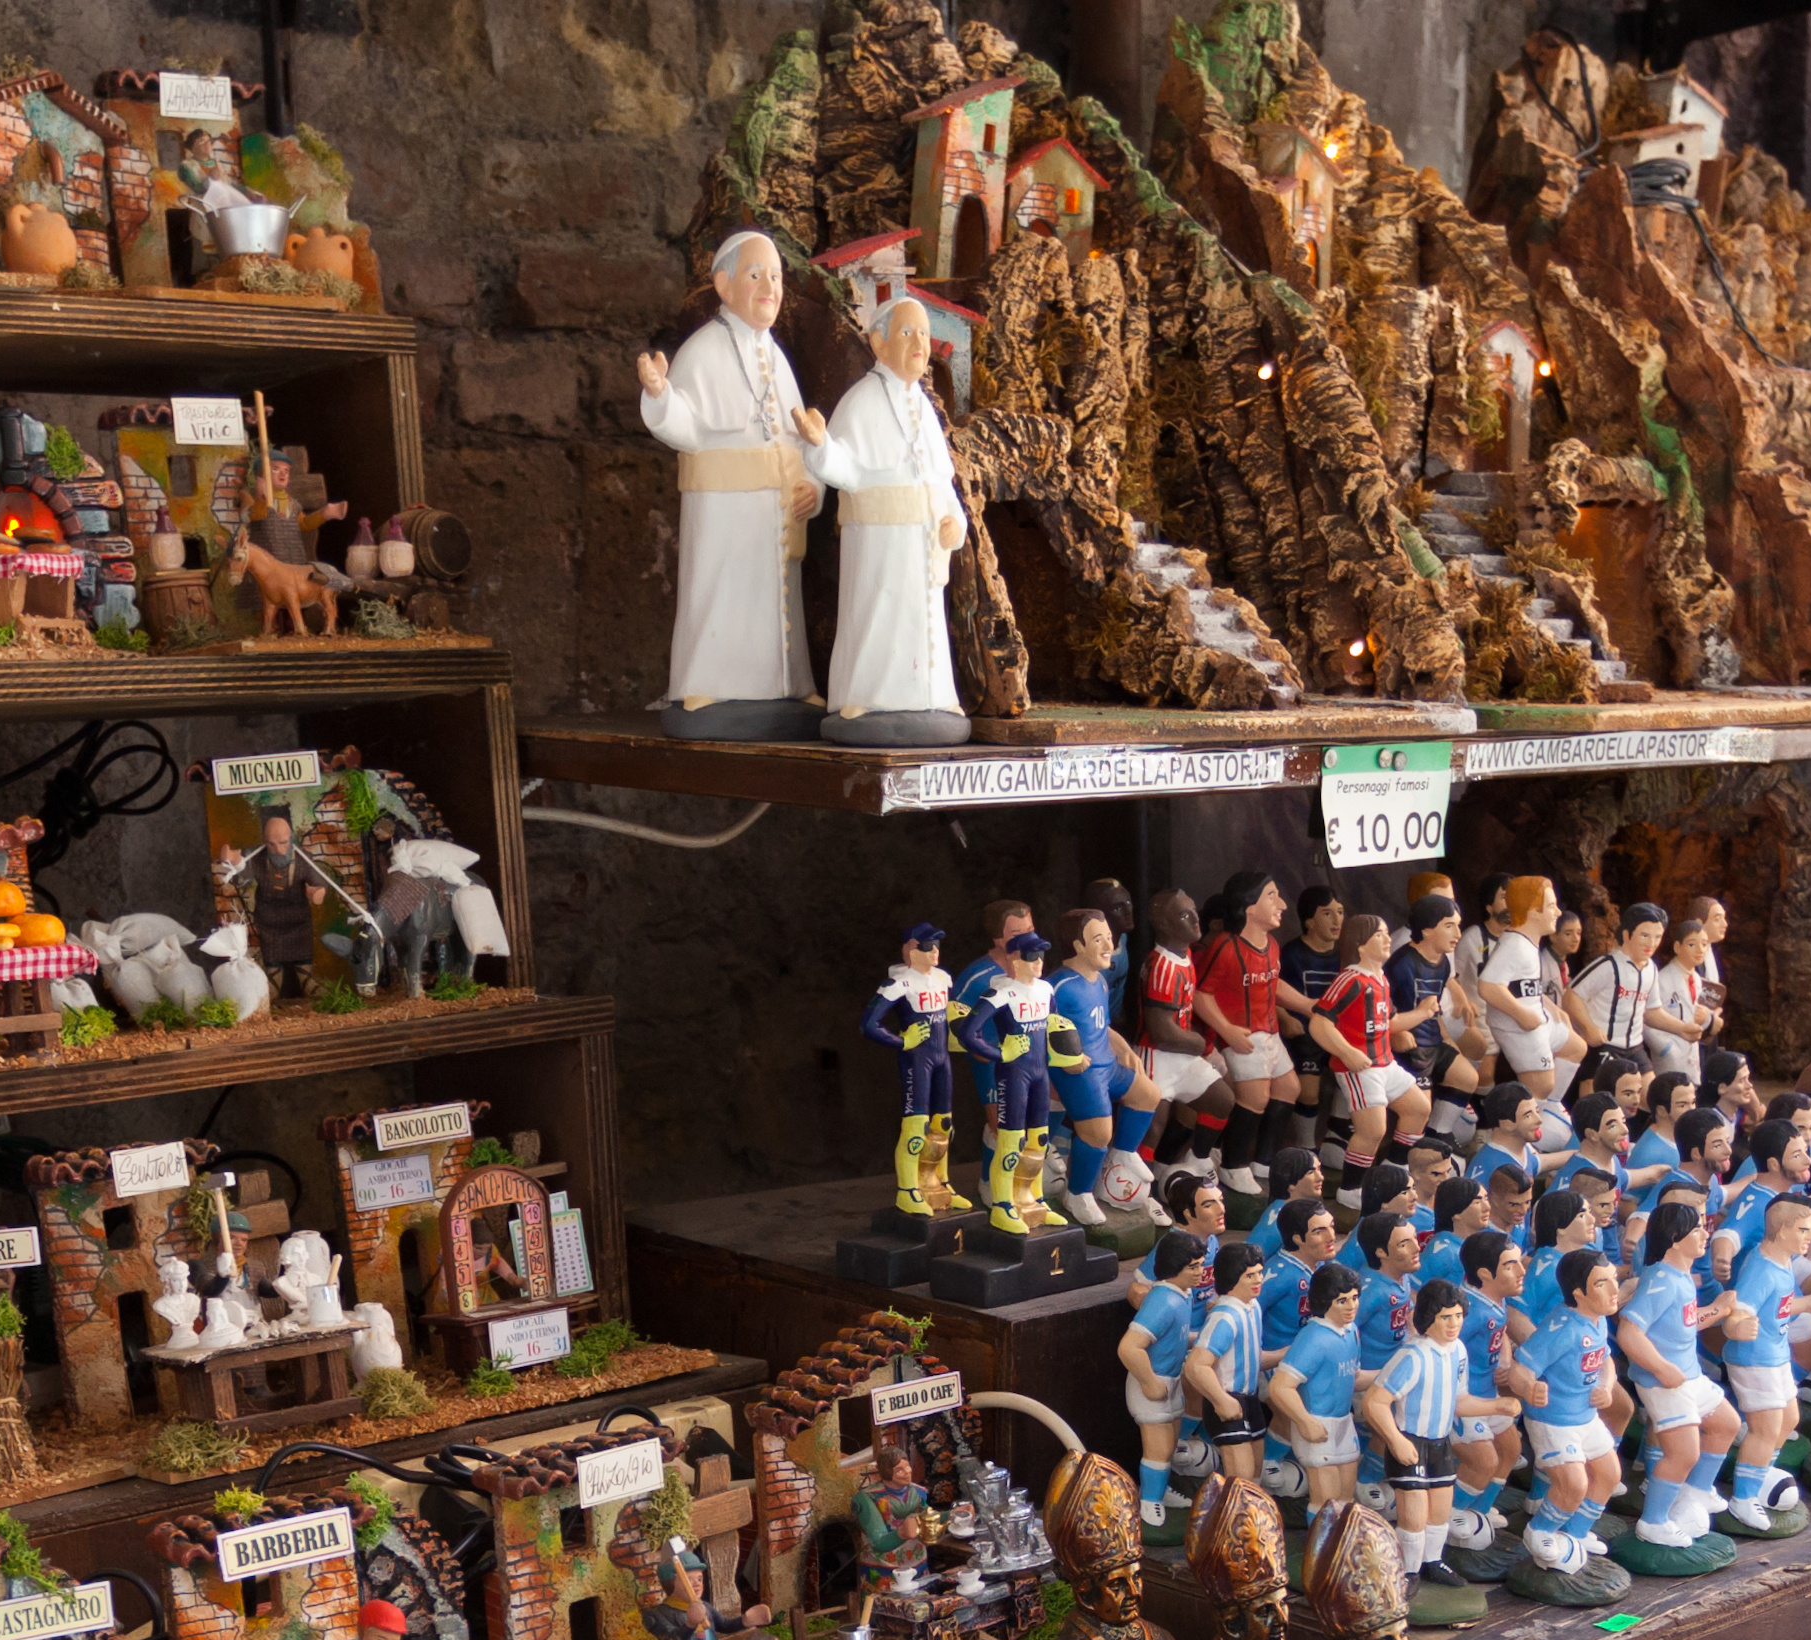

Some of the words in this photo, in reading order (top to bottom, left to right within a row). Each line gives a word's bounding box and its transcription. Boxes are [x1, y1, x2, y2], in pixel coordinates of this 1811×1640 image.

[191, 422, 231, 441] VINO
[228, 759, 303, 786] MUGNAIO
[1337, 779, 1391, 799] Personaggi
[1394, 777, 1431, 794] famosi
[1327, 817, 1342, 855] €
[1355, 811, 1443, 860] 10,00
[1019, 1002, 1047, 1020] FIAT
[1090, 1005, 1105, 1030] 10
[385, 1112, 463, 1142] BANCOLOTTO
[375, 1159, 408, 1173] GIOCATE
[358, 1188, 378, 1205] 90
[390, 1183, 405, 1199] 16
[417, 1180, 432, 1195] 31
[526, 1205, 540, 1222] 18
[453, 1221, 462, 1237] 6
[456, 1243, 464, 1257] 4
[1049, 1247, 1065, 1276] 1
[462, 1292, 470, 1306] 8
[512, 1315, 546, 1330] GIOCATE
[505, 1331, 528, 1345] AMBO
[534, 1325, 560, 1339] TERNO
[526, 1341, 541, 1357] 16
[553, 1337, 569, 1352] 31
[878, 1399, 887, 1414] E'
[890, 1391, 919, 1412] BELLO
[921, 1389, 928, 1404] O
[930, 1382, 956, 1402] CAFE'
[234, 1521, 341, 1568] BARBERIA
